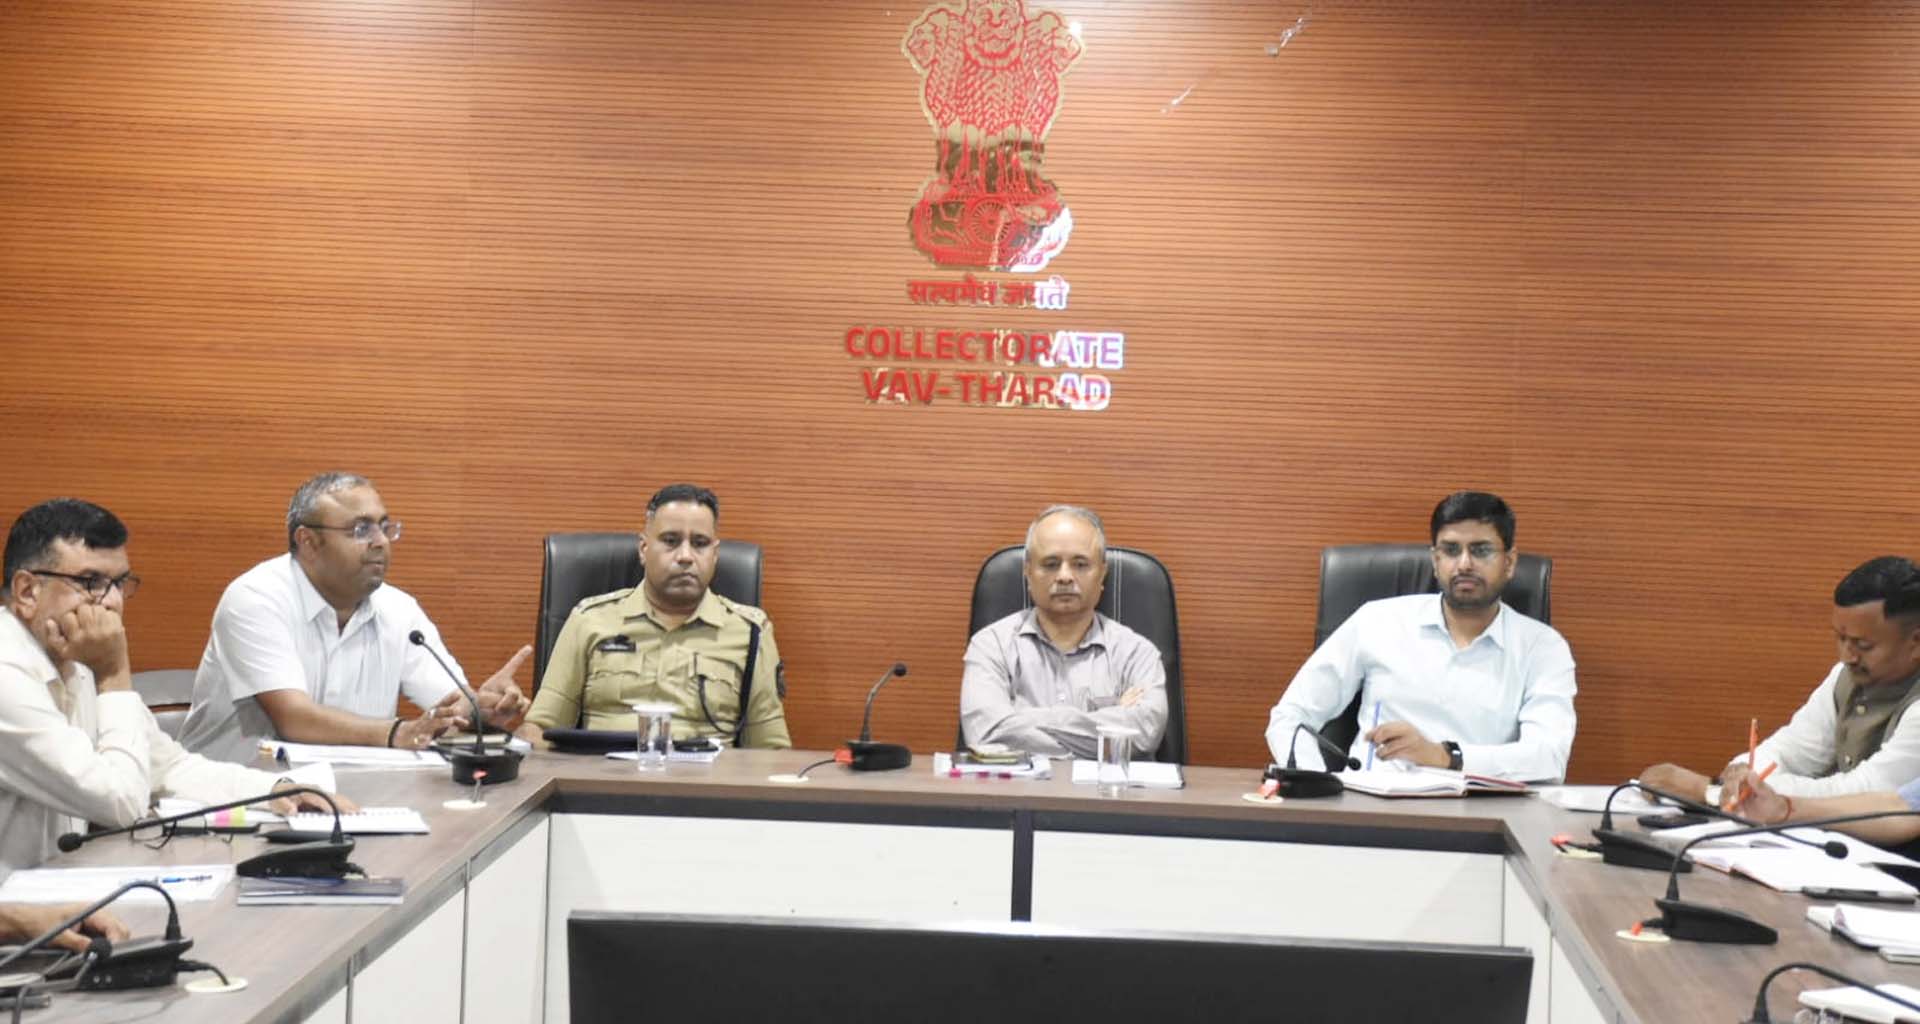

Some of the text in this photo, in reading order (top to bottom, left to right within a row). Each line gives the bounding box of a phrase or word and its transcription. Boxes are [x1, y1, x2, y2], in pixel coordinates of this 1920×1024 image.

[907, 274, 997, 304] सत्यमेव
[845, 327, 1123, 367] COLLECTORATE
[862, 369, 1108, 405] VAV-THARAD
